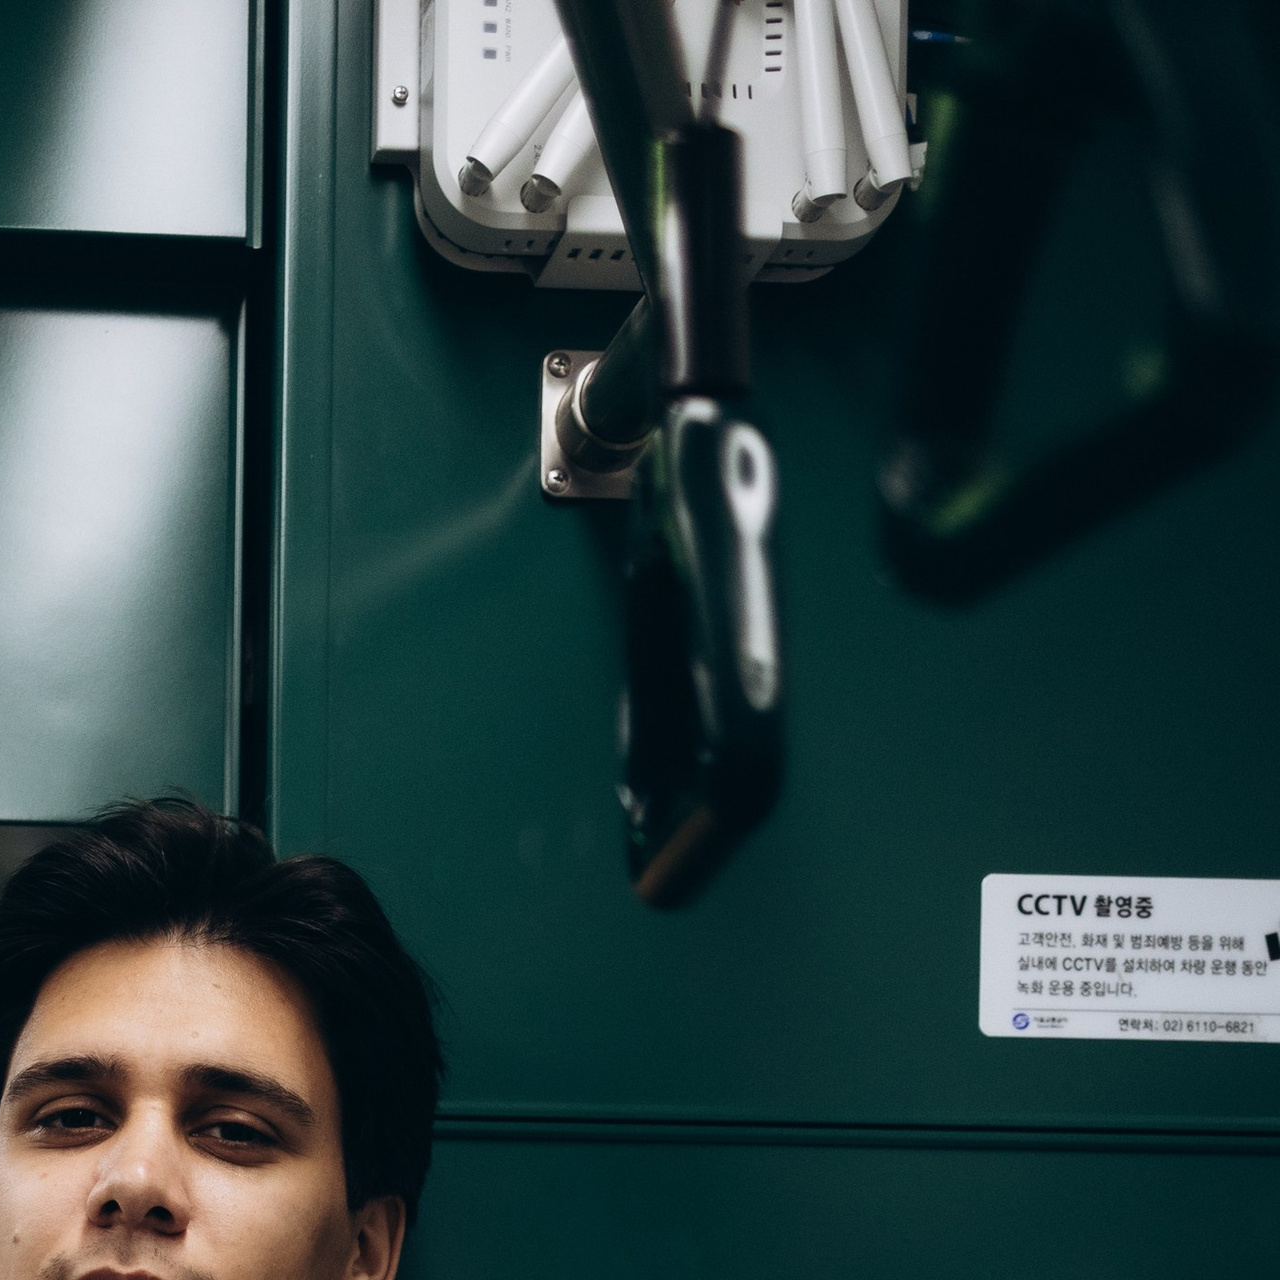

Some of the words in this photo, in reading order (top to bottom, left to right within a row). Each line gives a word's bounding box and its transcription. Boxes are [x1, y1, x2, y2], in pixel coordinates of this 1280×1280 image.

[1017, 894, 1088, 917] CCTV
[1094, 895, 1154, 919] 촬영중
[1081, 932, 1108, 949] 화재
[1112, 933, 1125, 949] 및
[1130, 934, 1183, 951] 범죄예방
[1187, 934, 1214, 952] 등을
[1218, 936, 1245, 952] 위해
[1018, 956, 1058, 971] 실내에
[1062, 957, 1117, 974] CCTV를
[1122, 958, 1176, 974] 설치하여
[1180, 959, 1206, 975] 차량
[1210, 960, 1237, 976] 운행
[1241, 960, 1269, 977] 동안
[1017, 980, 1044, 995] 녹화
[1048, 980, 1075, 997] 운용
[1079, 981, 1138, 998] 중입니다.
